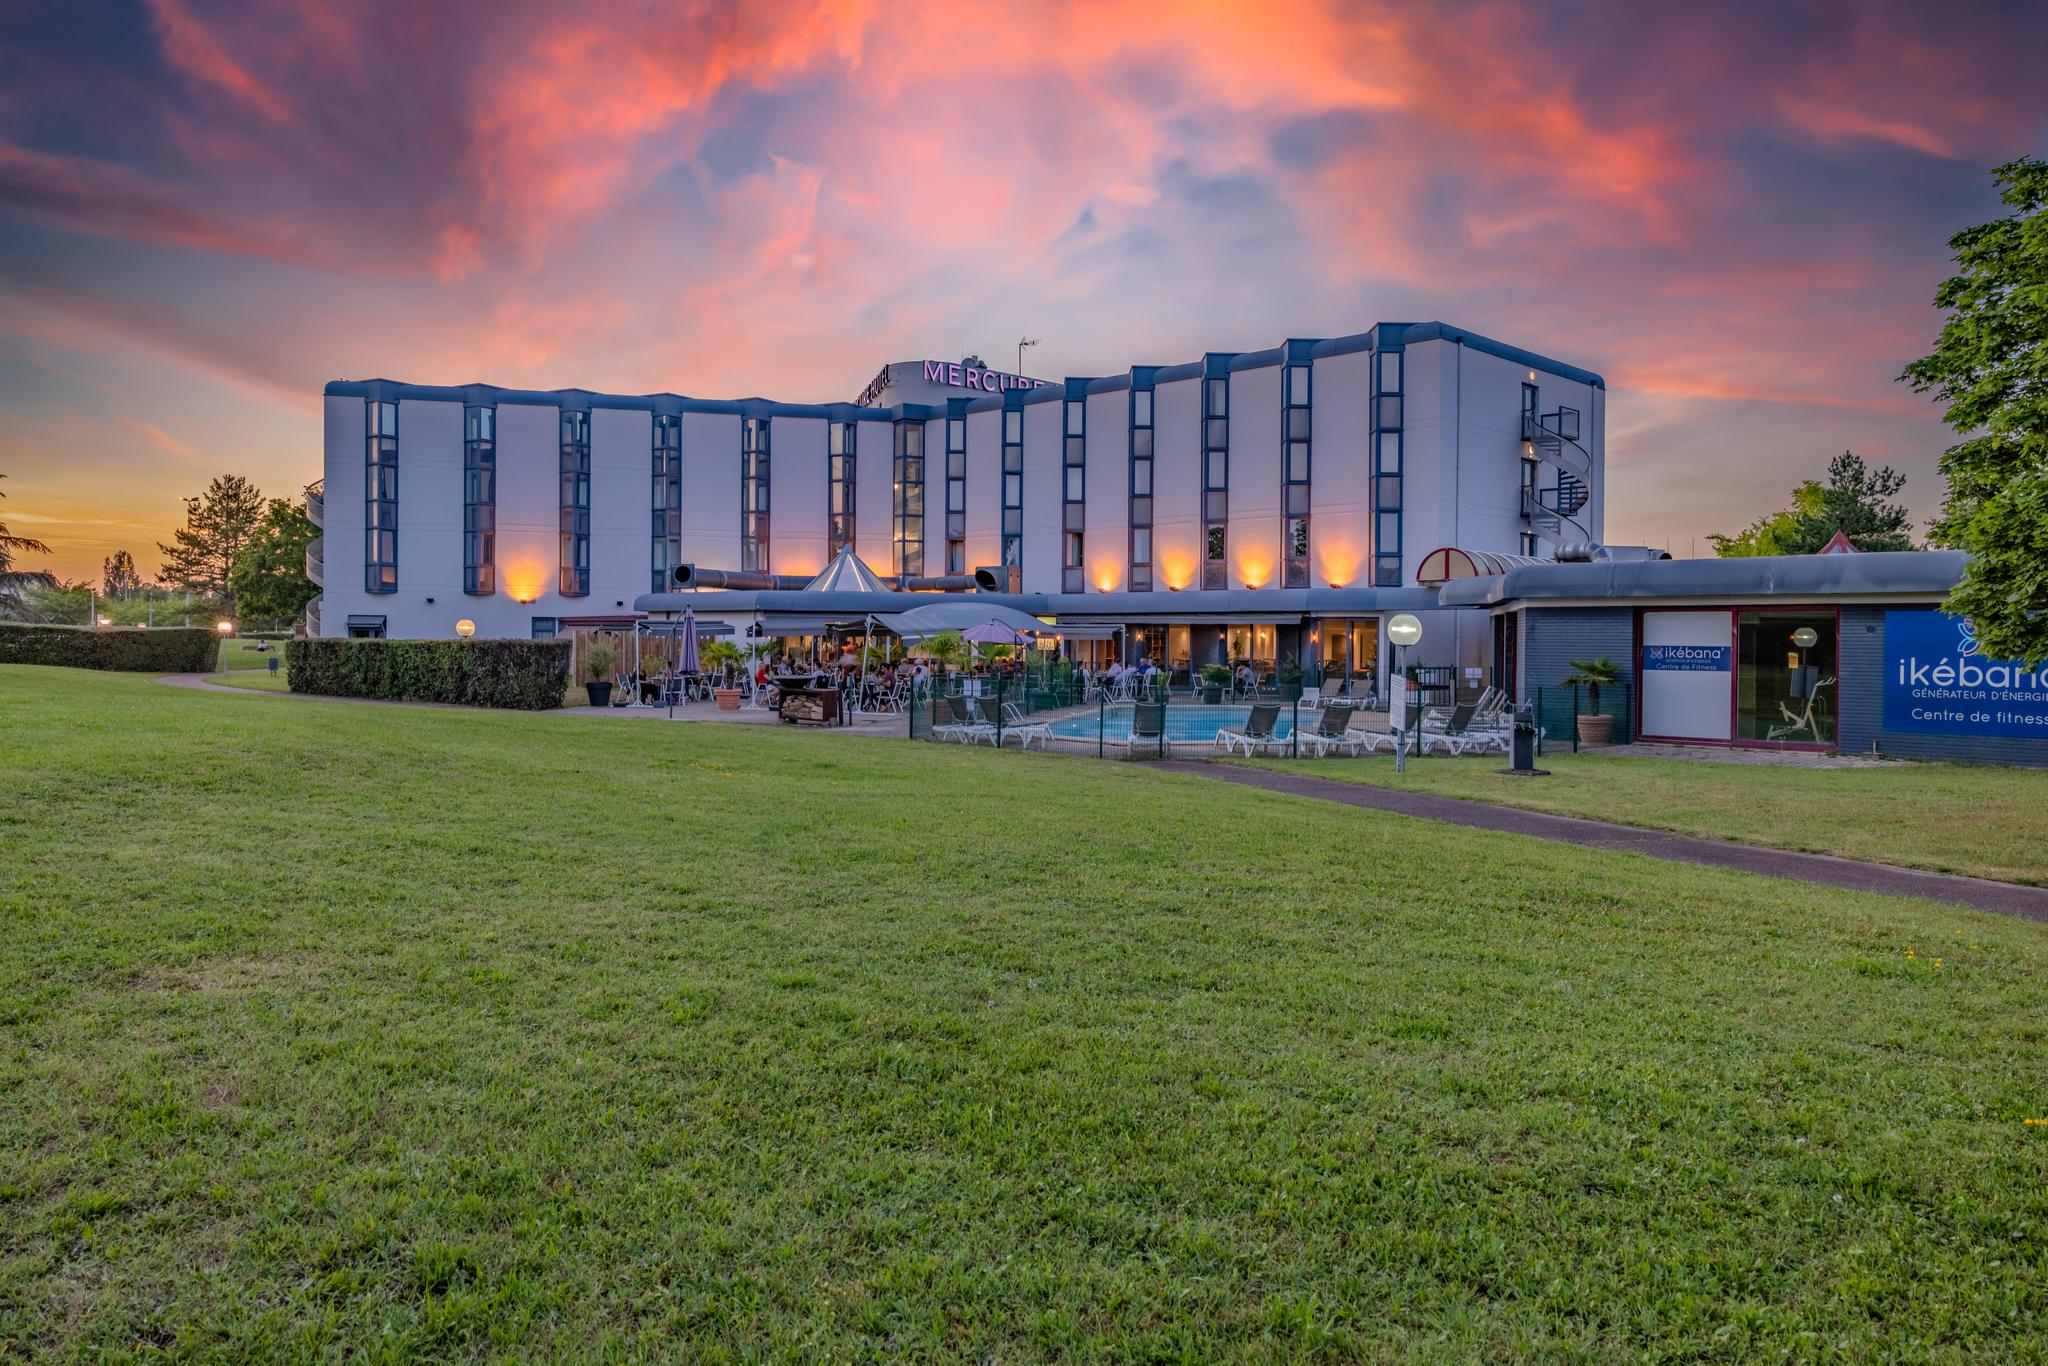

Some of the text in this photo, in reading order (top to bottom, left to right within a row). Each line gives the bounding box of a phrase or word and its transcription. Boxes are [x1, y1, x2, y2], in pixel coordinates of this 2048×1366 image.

[1912, 688, 1986, 700] GÉNÉRATEUR
[1911, 708, 1965, 721] Centre
[1970, 711, 1991, 723] de
